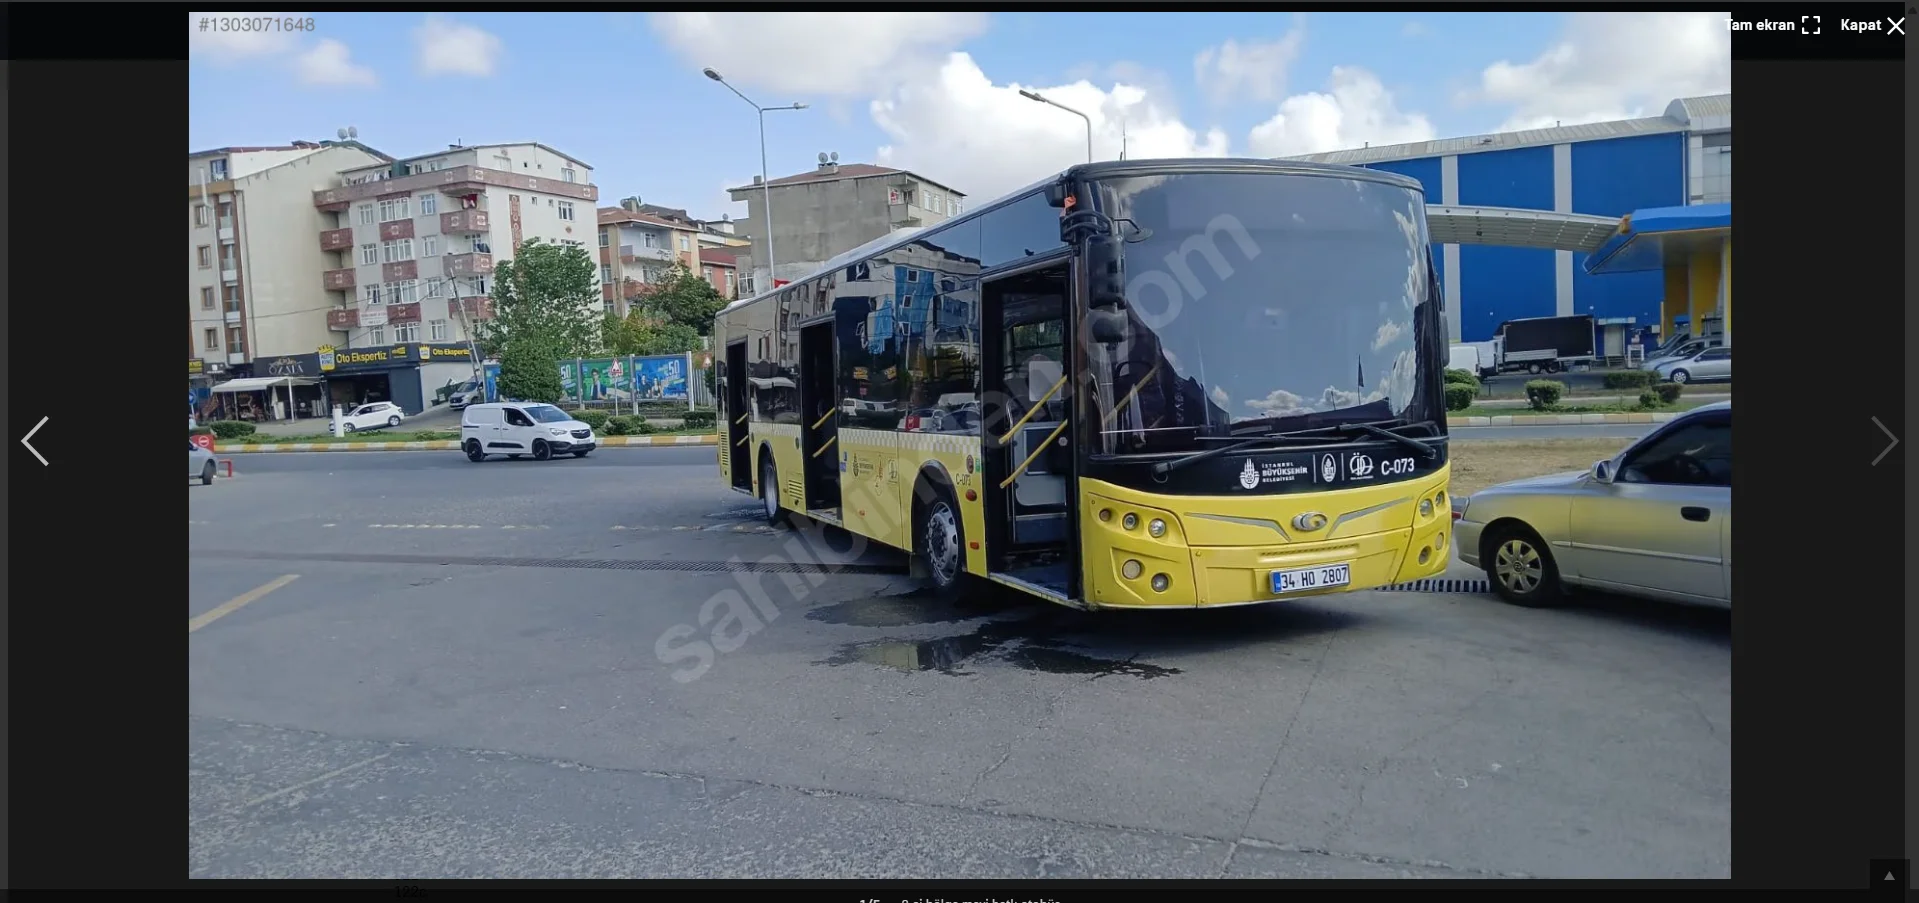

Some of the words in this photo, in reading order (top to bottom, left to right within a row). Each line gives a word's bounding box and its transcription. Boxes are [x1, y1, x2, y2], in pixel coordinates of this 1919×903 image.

[335, 353, 350, 364] Oto
[351, 350, 388, 363] Ekspertiz
[1380, 457, 1415, 476] C-073
[1281, 573, 1296, 589] 34
[1321, 567, 1348, 585] 2807
